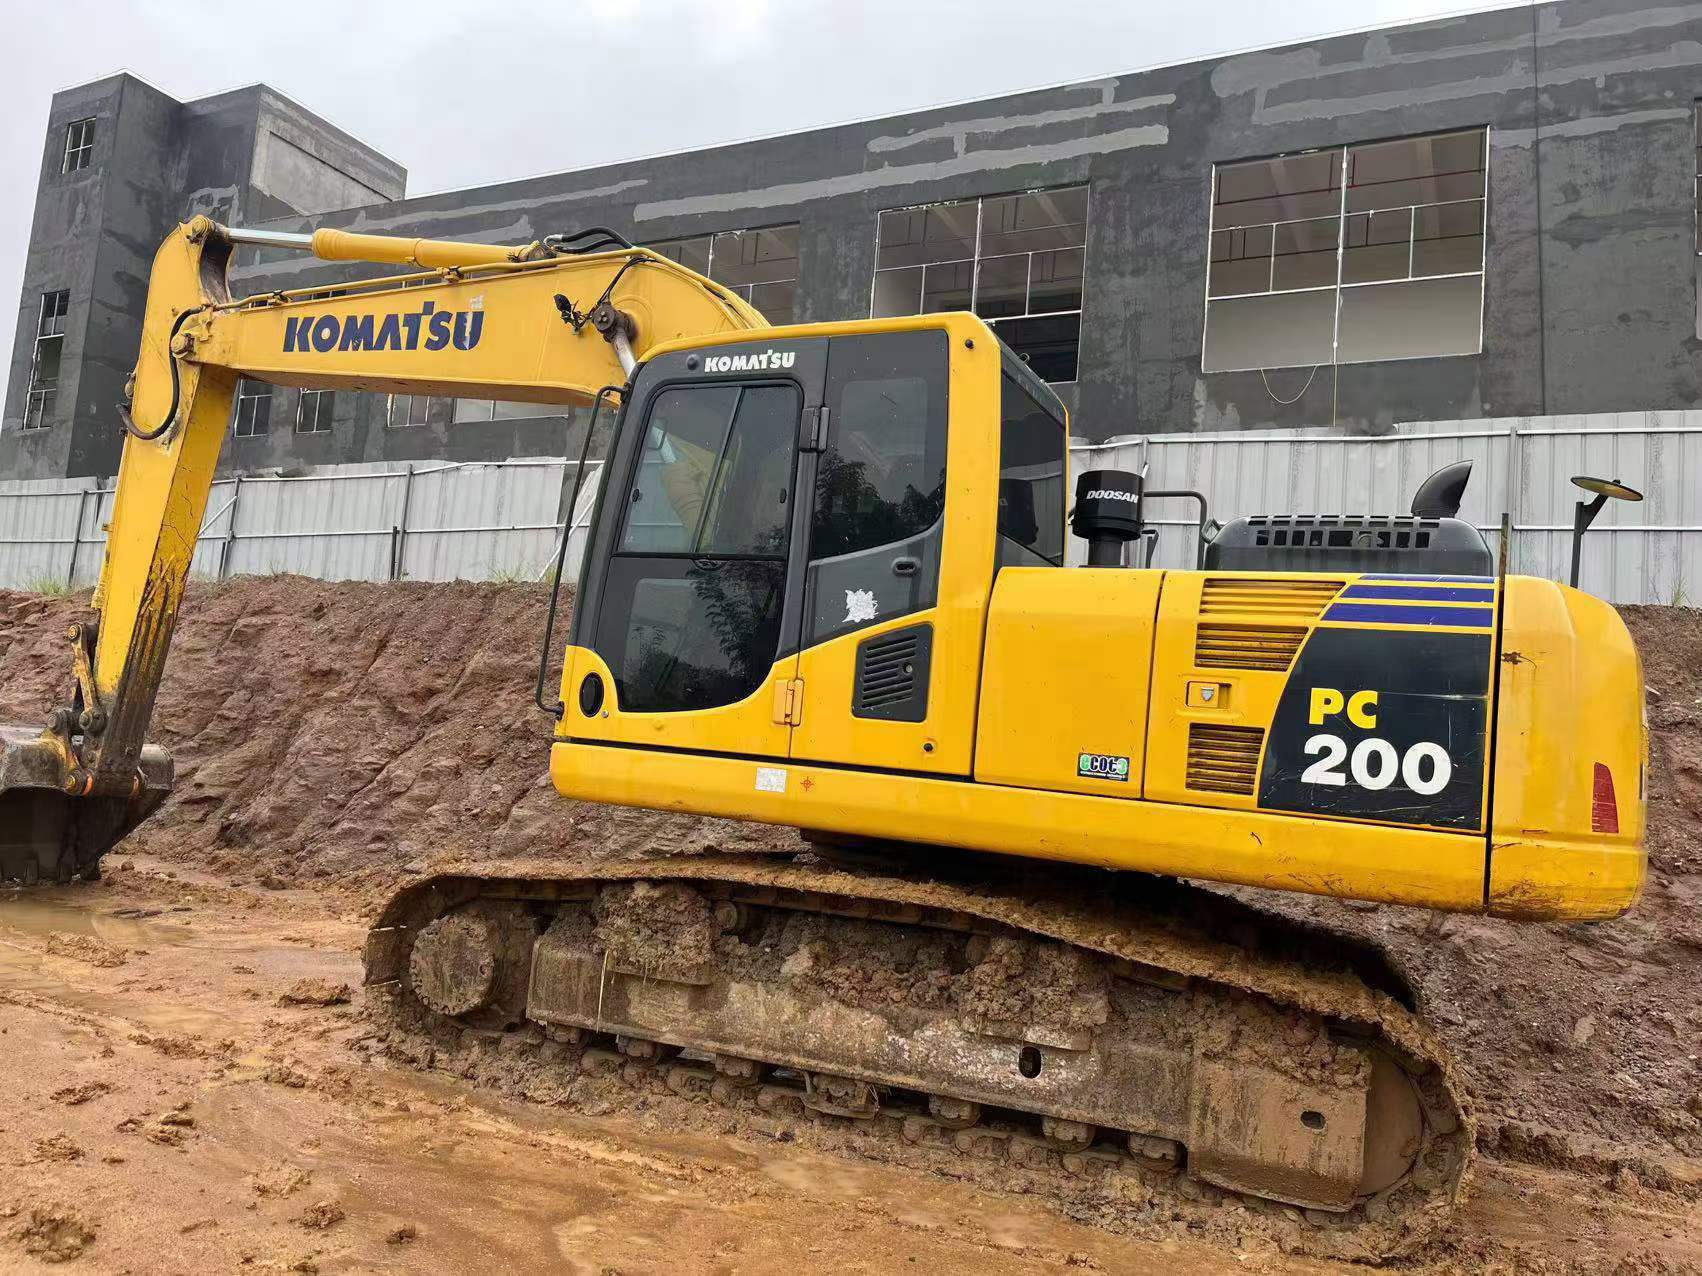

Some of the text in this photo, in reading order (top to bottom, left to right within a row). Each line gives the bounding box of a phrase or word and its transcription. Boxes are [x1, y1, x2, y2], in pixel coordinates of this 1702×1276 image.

[283, 301, 484, 352] KOMATSU
[704, 349, 795, 372] KOMATSU
[1086, 490, 1139, 503] DOOSAN
[1309, 687, 1379, 730] PC
[1301, 734, 1452, 796] 200
